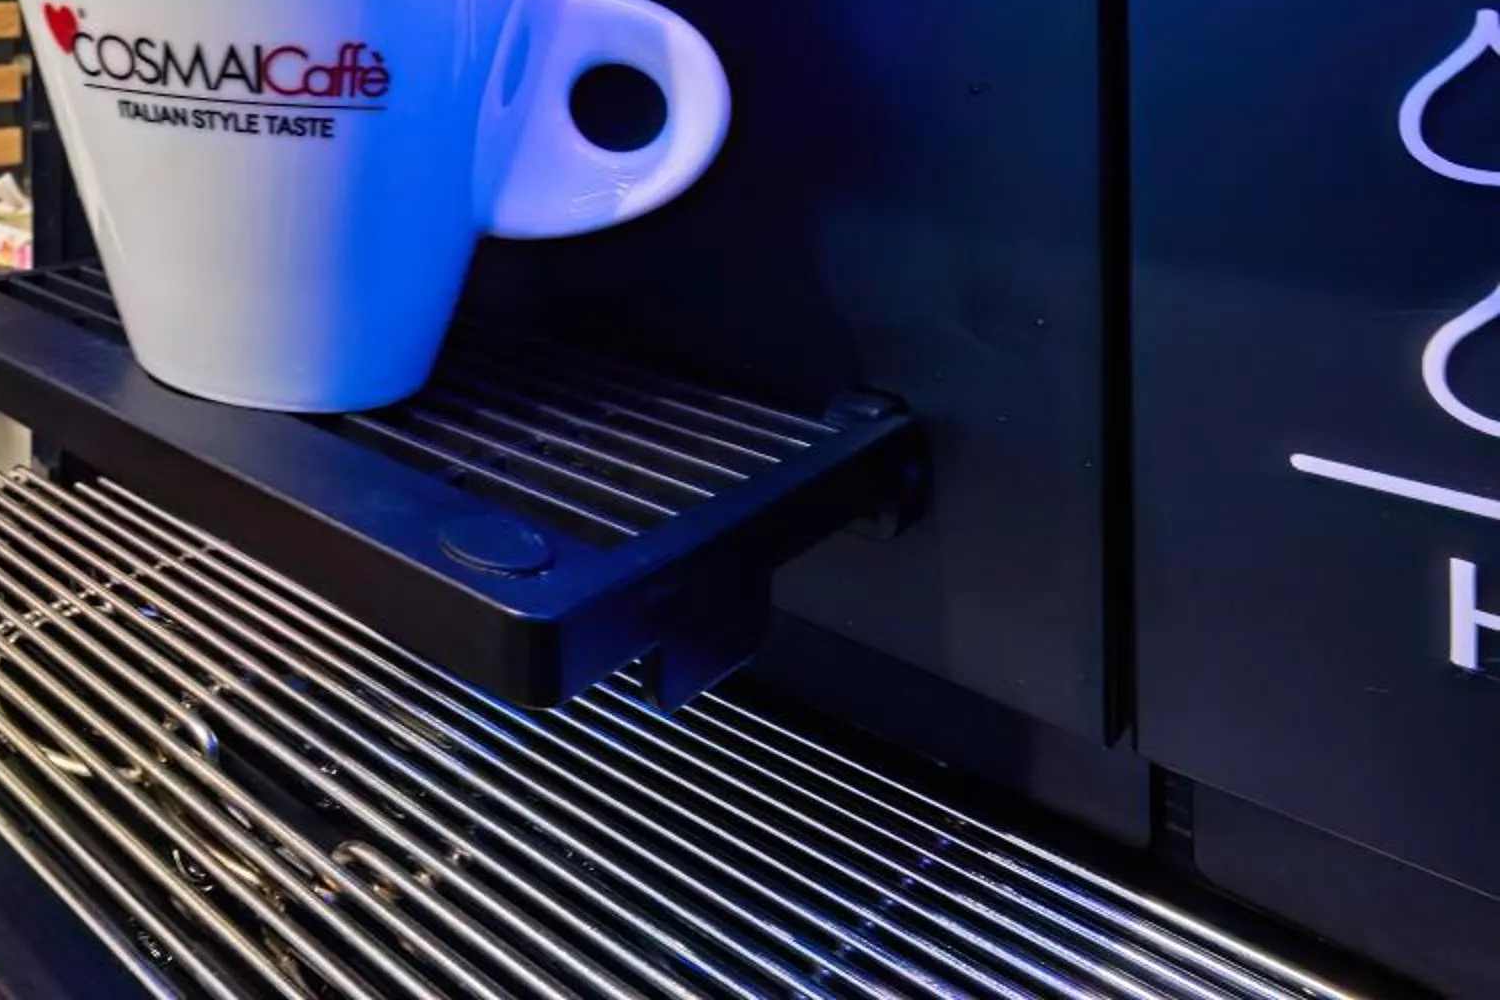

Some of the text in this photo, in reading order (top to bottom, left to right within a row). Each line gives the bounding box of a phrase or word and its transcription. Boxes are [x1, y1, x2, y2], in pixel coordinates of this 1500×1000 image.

[118, 100, 334, 139] ITALIAN STYLE TASTE
